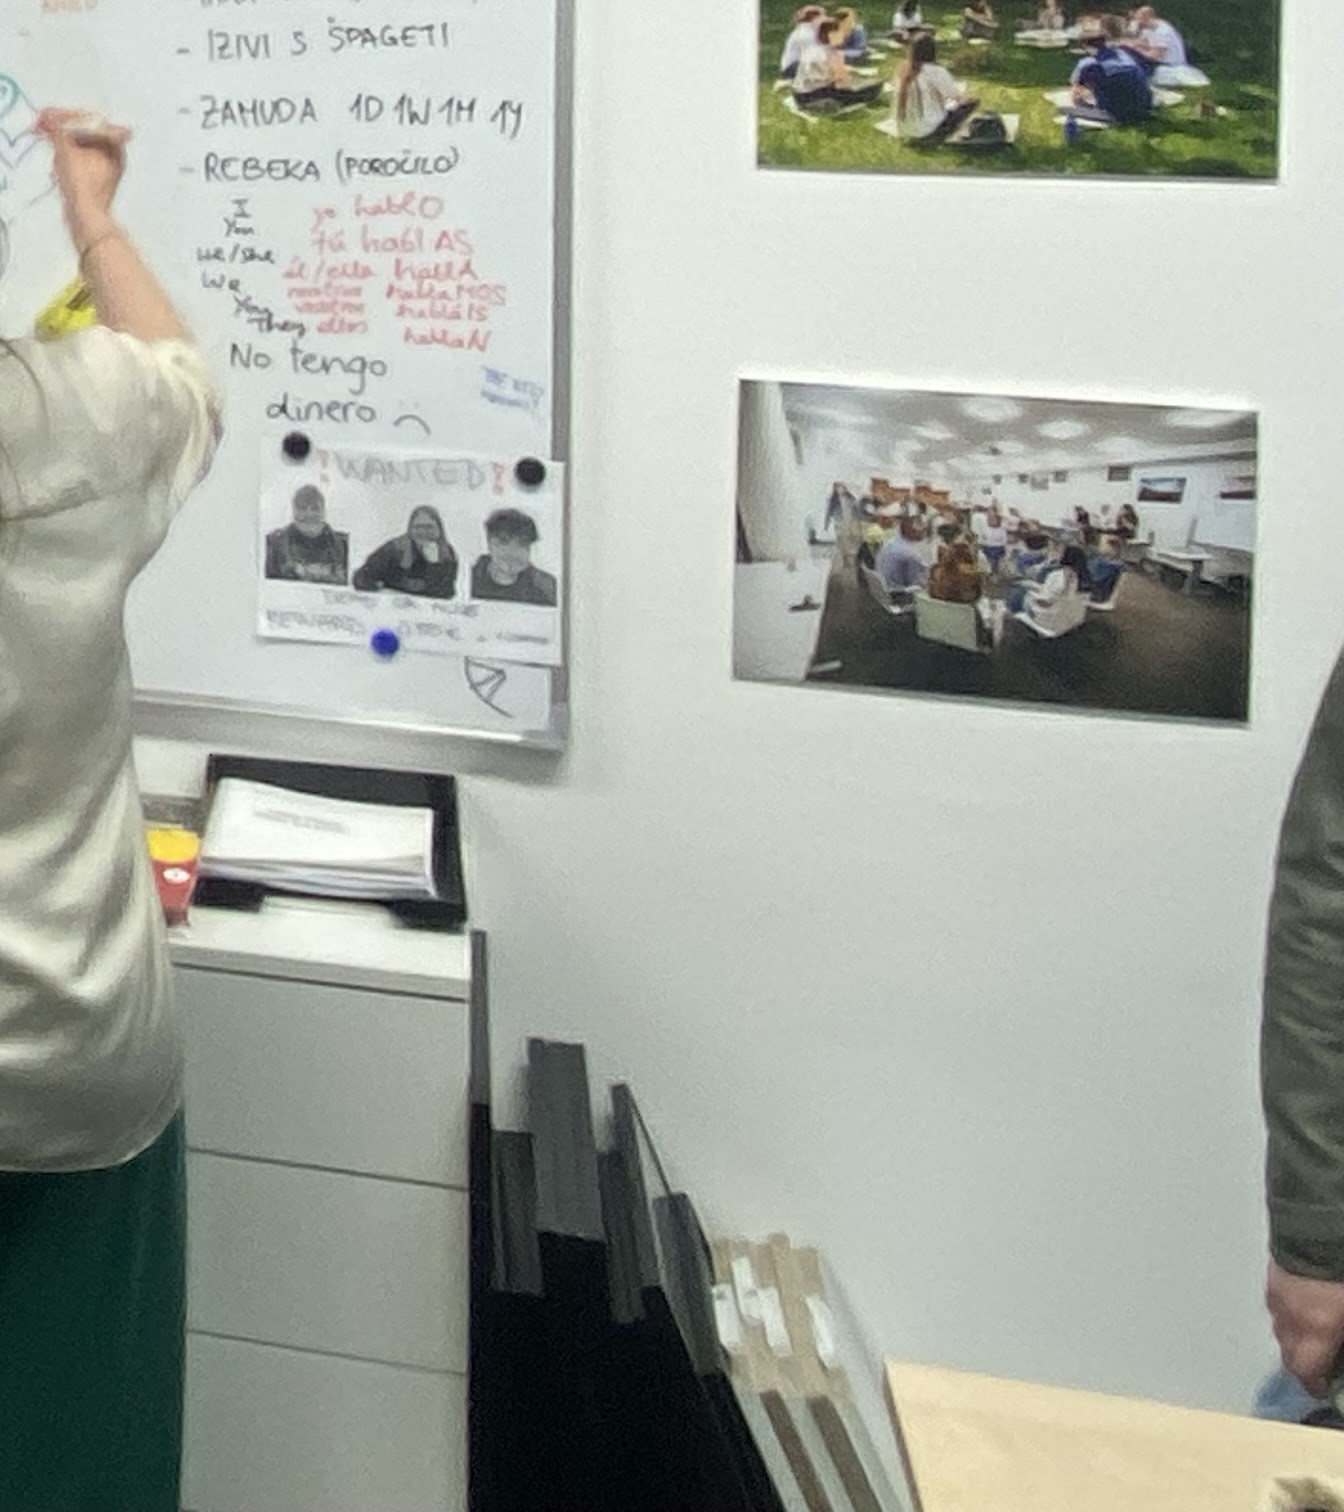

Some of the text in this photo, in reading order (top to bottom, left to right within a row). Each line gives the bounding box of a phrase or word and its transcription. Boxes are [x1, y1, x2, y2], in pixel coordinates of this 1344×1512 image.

[291, 29, 308, 57] S
[201, 93, 318, 130] ZAMUDA
[204, 152, 320, 182] REBEKA
[230, 337, 389, 396] No tengo
[266, 392, 378, 424] dinero
